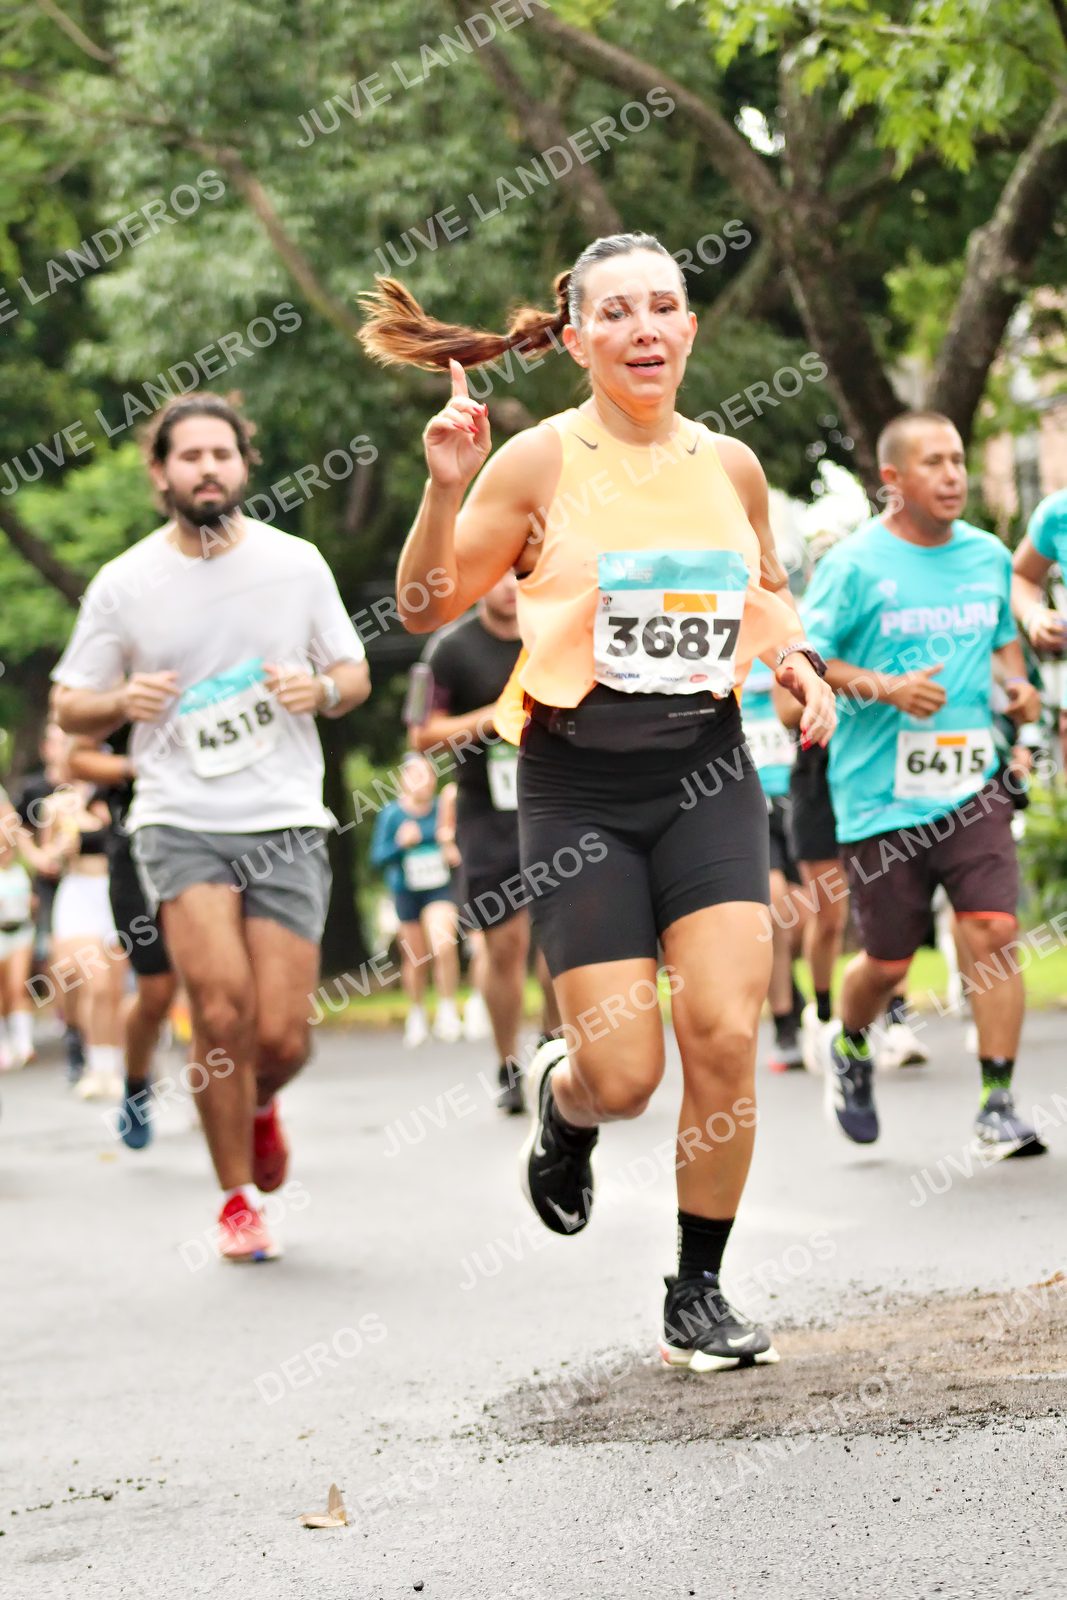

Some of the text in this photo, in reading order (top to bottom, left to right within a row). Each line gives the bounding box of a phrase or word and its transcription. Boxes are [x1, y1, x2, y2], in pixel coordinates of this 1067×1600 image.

[606, 616, 741, 661] 3687
[198, 701, 273, 750] 4318
[906, 748, 985, 775] 6415
